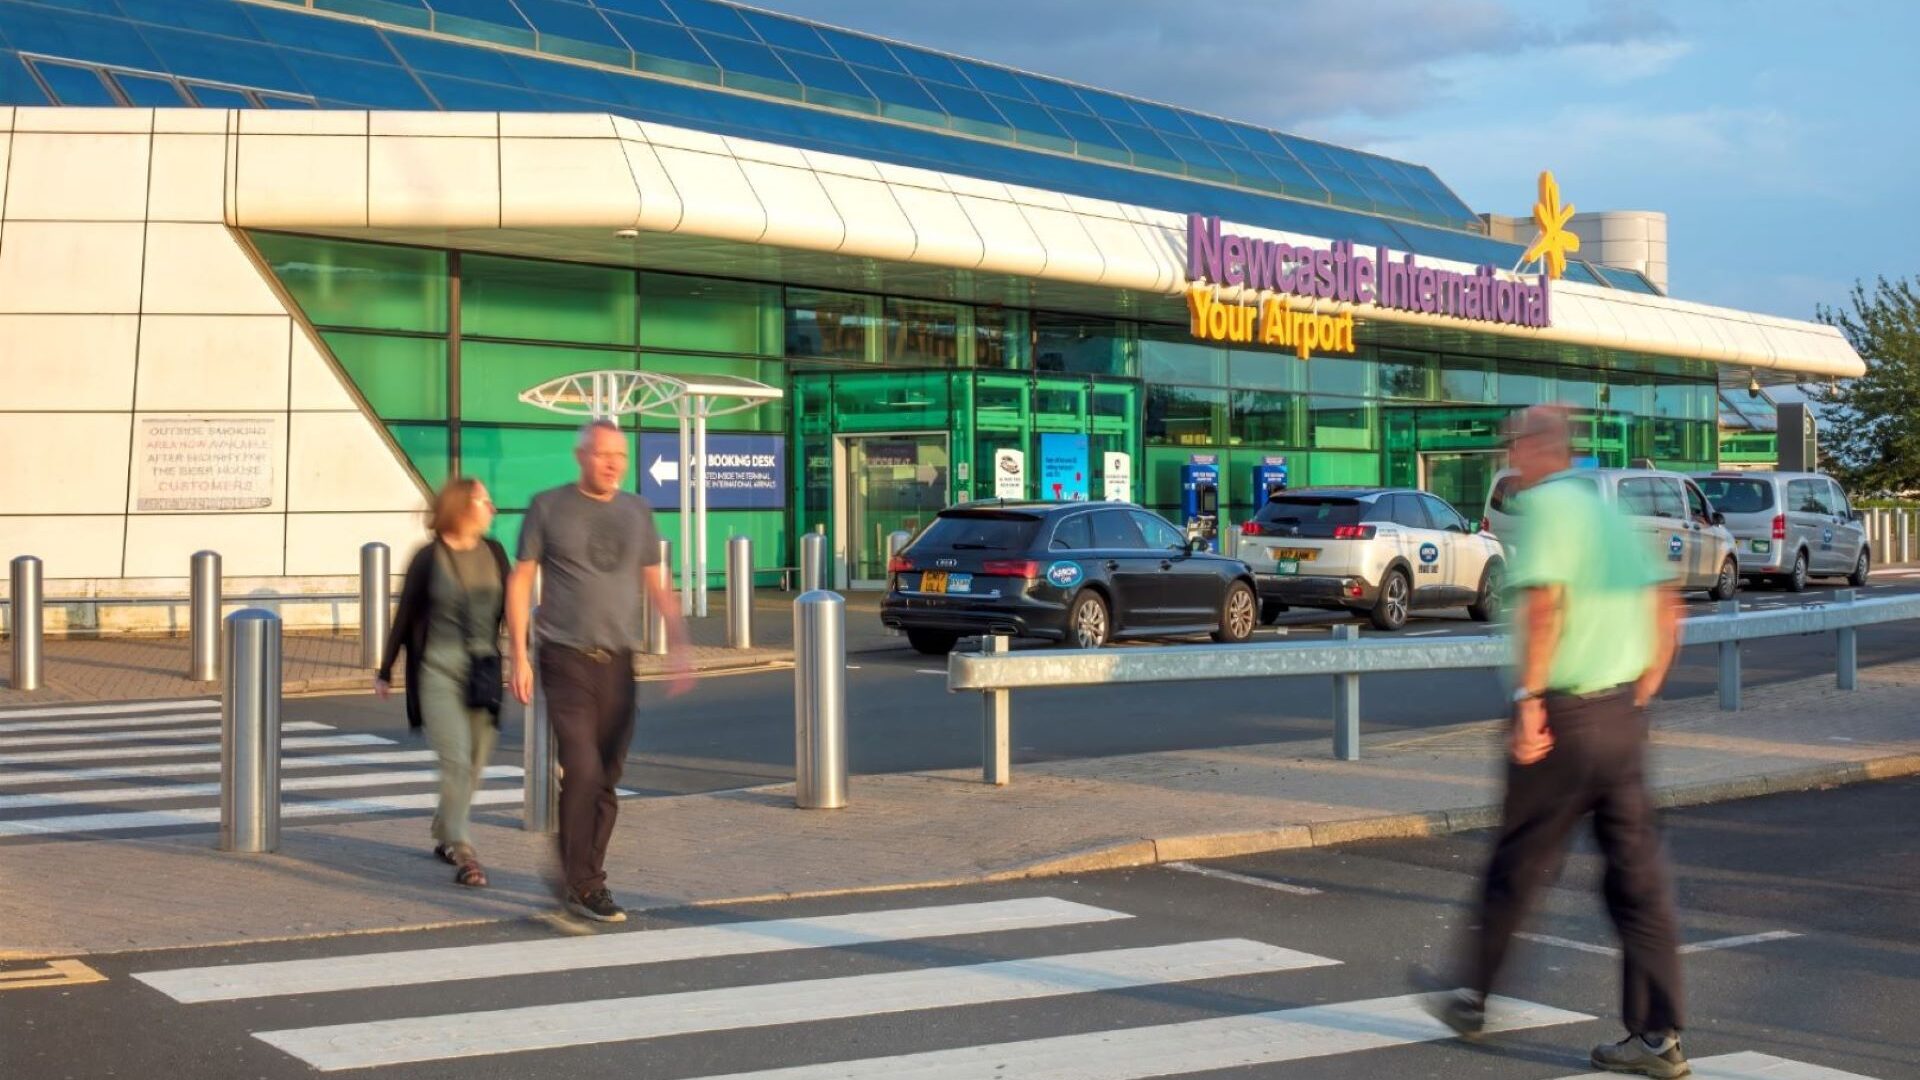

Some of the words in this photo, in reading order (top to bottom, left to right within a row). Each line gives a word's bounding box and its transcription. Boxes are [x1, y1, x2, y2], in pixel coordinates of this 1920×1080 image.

[1187, 211, 1375, 304] Newcastle
[1375, 245, 1552, 329] International
[1188, 286, 1257, 343] Your
[1260, 296, 1356, 361] Airport
[708, 453, 751, 467] BOOKING
[752, 454, 776, 467] DESK
[158, 481, 253, 491] CUSTOMERS
